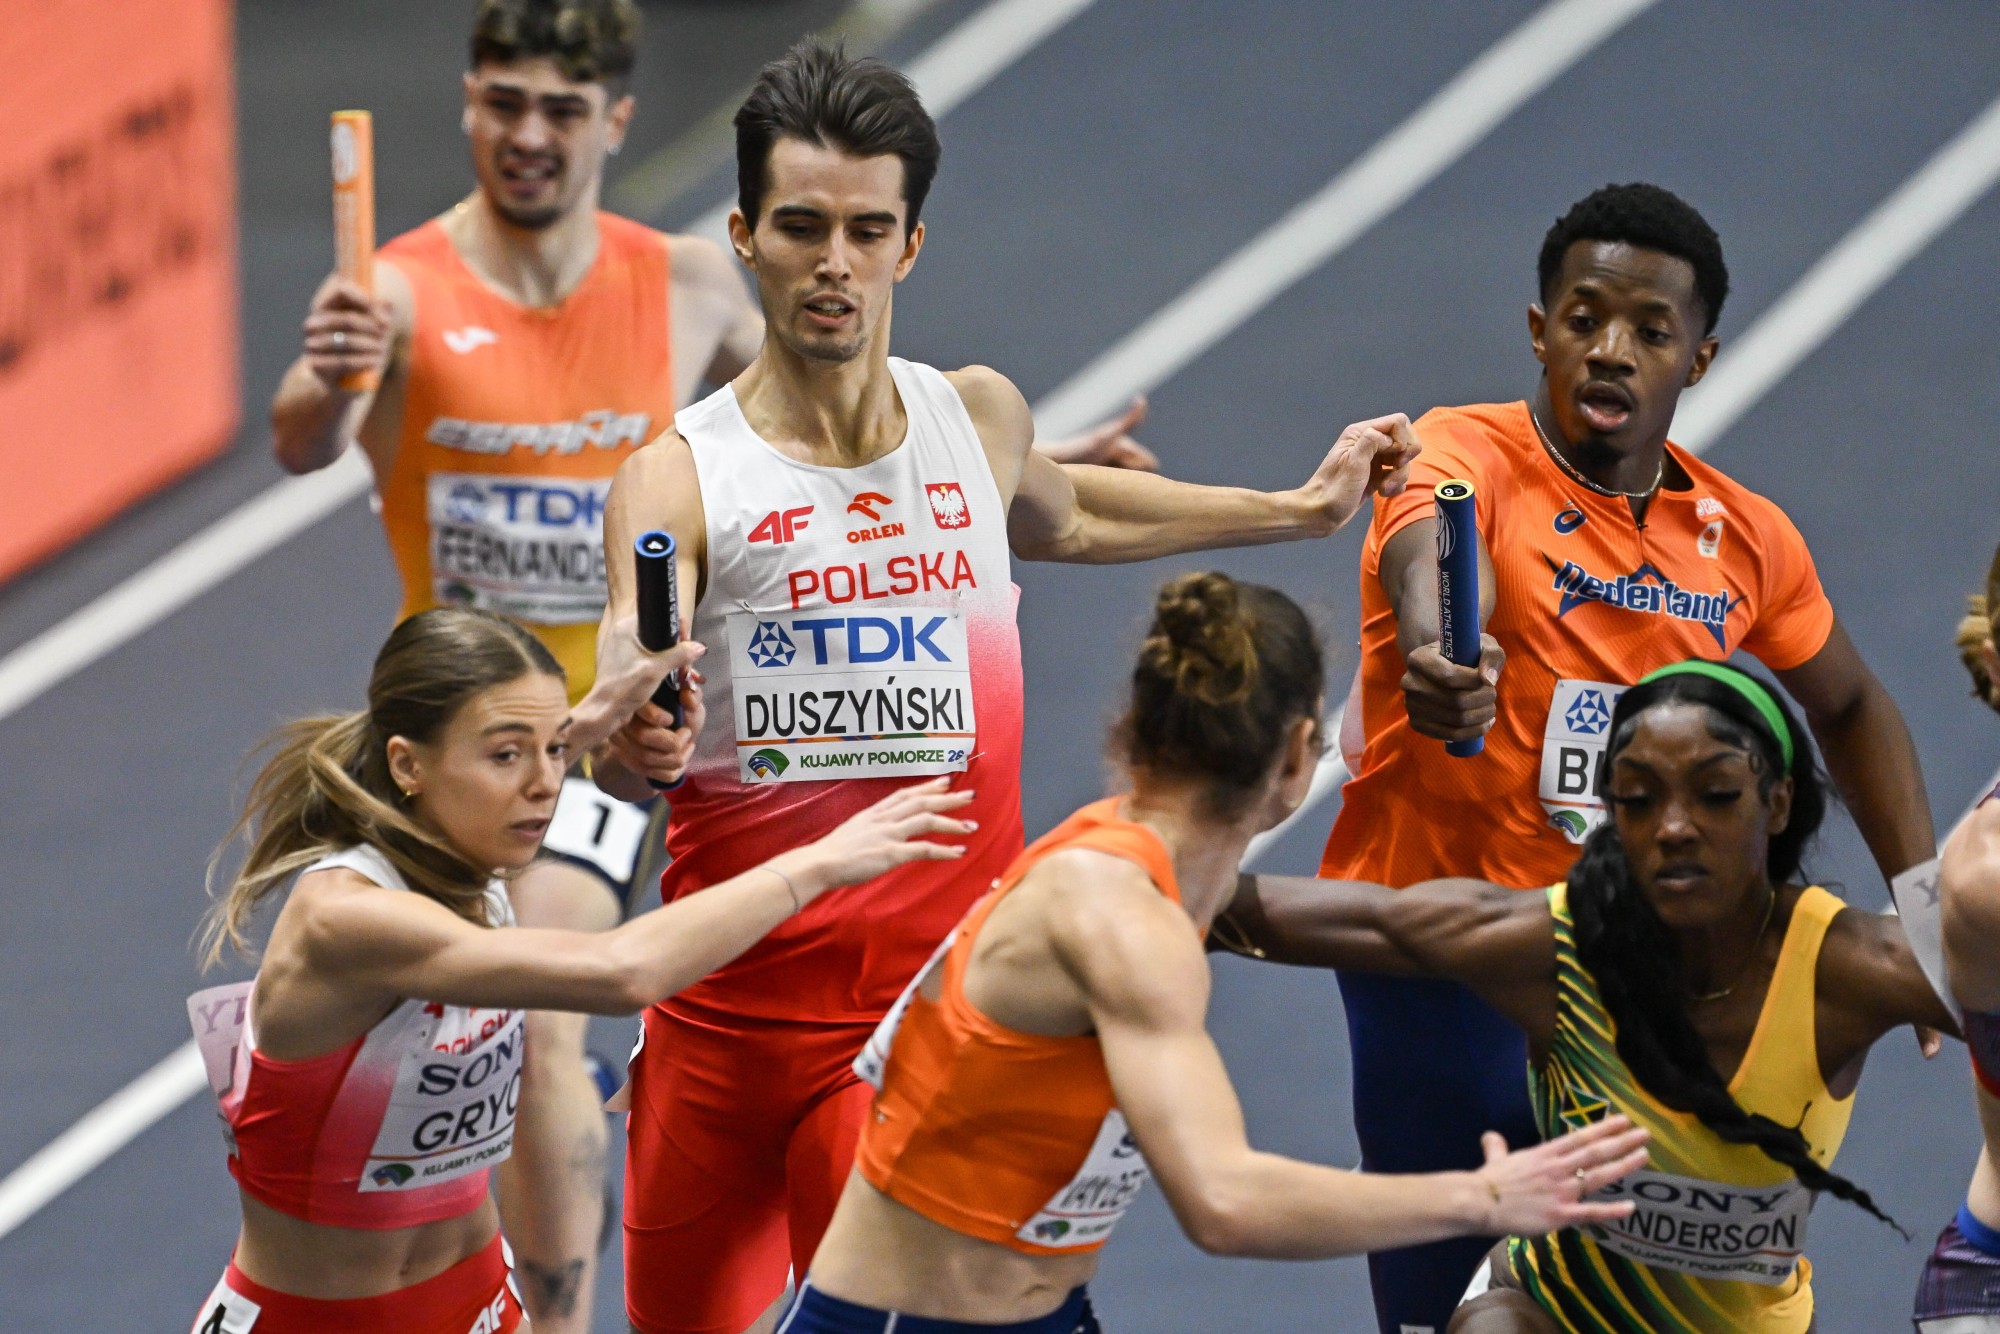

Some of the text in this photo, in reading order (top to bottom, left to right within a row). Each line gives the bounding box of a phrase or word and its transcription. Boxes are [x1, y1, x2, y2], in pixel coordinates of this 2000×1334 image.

[747, 505, 814, 544] 4F
[846, 522, 905, 544] ORLEN
[787, 550, 977, 609] POLSKA
[1441, 571, 1451, 606] WORLD
[792, 616, 952, 665] TDK
[1443, 606, 1454, 659] ATHLETICS
[745, 676, 965, 738] DUSZYŃSKI
[800, 753, 864, 768] KUJAWY
[868, 750, 944, 765] POMORZE
[594, 802, 611, 846] 1
[1689, 1260, 1768, 1277] POMORZE
